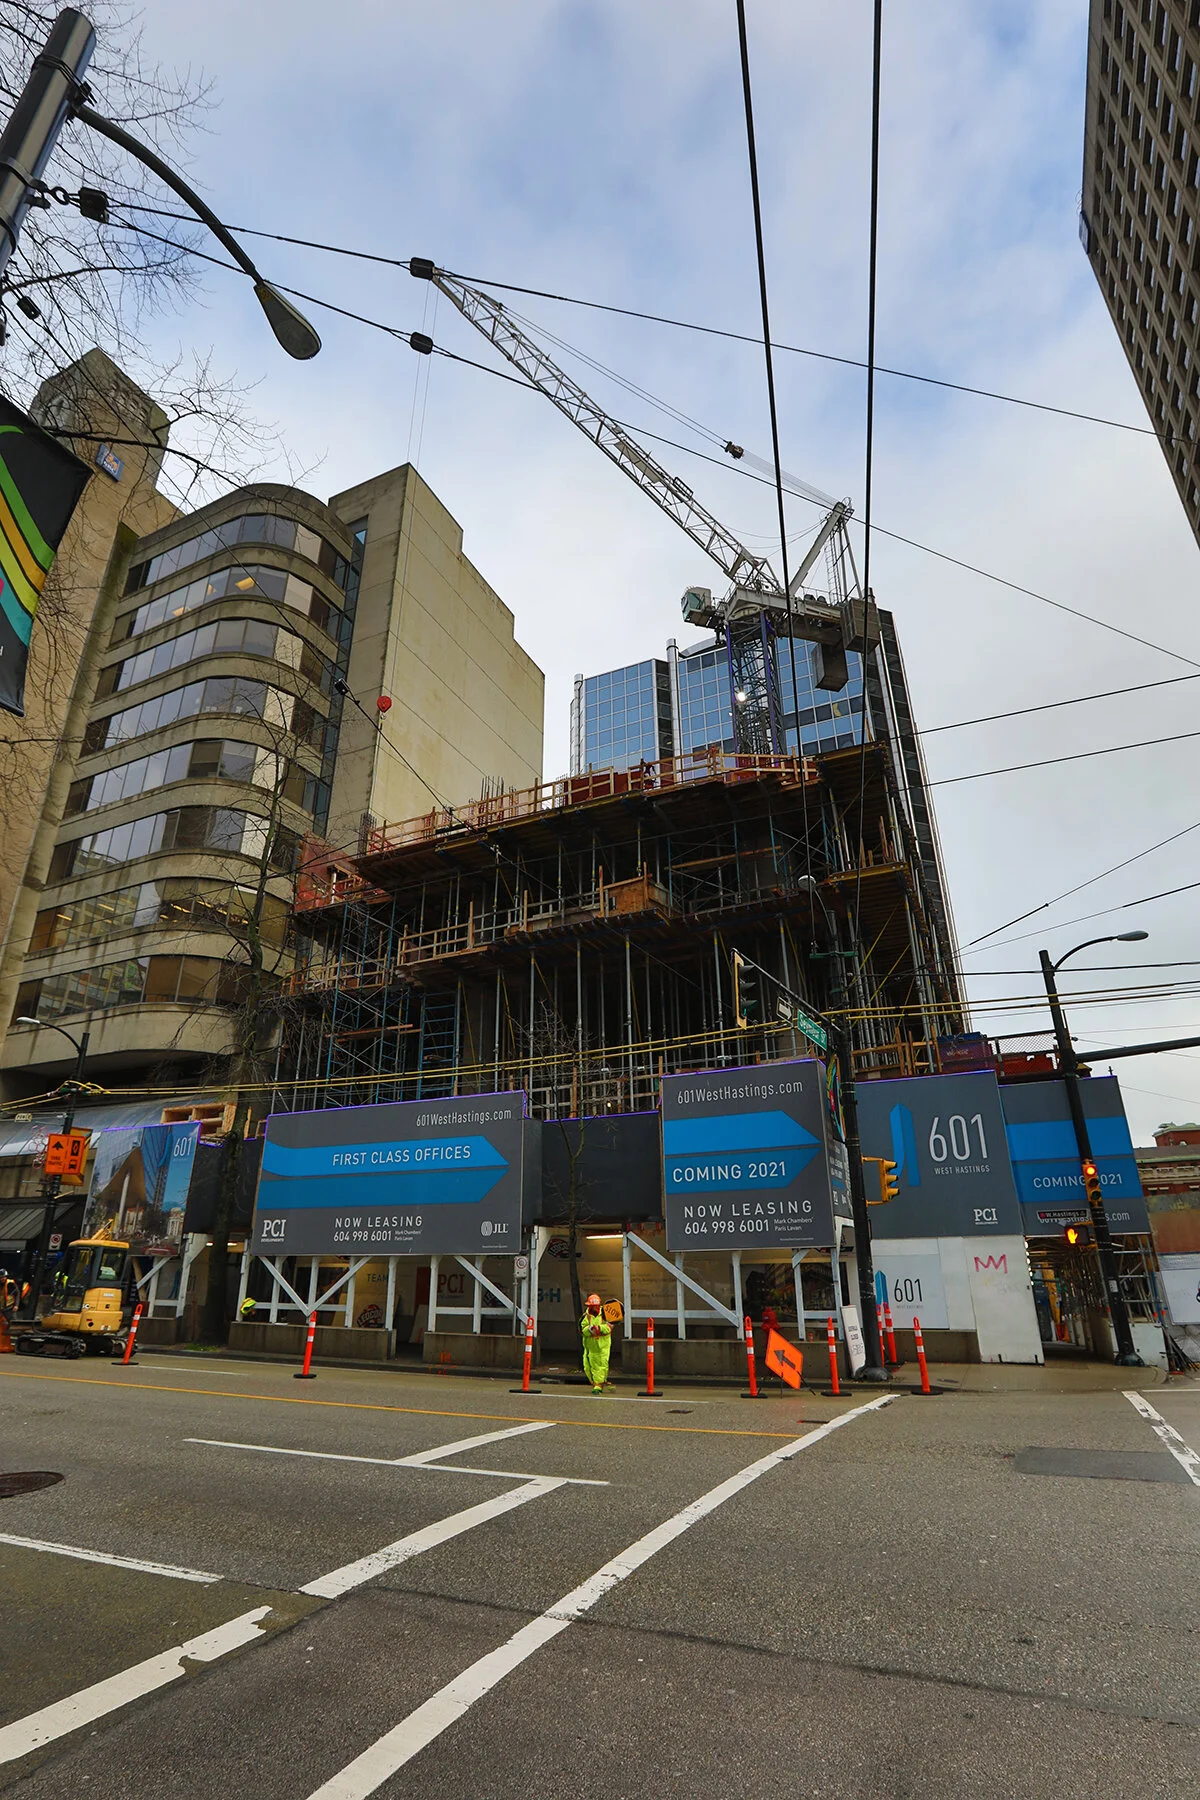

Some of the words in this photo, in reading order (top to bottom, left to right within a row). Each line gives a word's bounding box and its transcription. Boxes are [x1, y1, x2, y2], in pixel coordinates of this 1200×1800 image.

[677, 1081, 803, 1105] 601WestHastings.com
[416, 1109, 512, 1127] 601WestHastings.com
[929, 1113, 988, 1162] 601
[173, 1137, 192, 1157] 601
[332, 1152, 367, 1166] FIRST
[371, 1150, 410, 1164] CLASS
[415, 1145, 471, 1162] OFFICES
[672, 1164, 742, 1183] COMING
[748, 1161, 786, 1178] 2021
[934, 1166, 953, 1175] WEST
[955, 1164, 990, 1174] HASTINGS
[1099, 1173, 1123, 1185] 021
[684, 1204, 723, 1218] NOW
[732, 1200, 812, 1217] LEASING
[973, 1208, 998, 1222] PCI
[261, 1219, 287, 1238] PCI
[335, 1217, 363, 1228] NOW
[367, 1215, 423, 1228] LEASING
[493, 1223, 508, 1234] JLL
[684, 1221, 708, 1235] 604
[712, 1220, 735, 1234] 998
[739, 1219, 770, 1233] 6001
[334, 1231, 350, 1242] 604
[352, 1230, 369, 1242] 998
[371, 1230, 392, 1241] 6001
[893, 1278, 923, 1302] 601
[604, 1305, 621, 1319] SLOW
